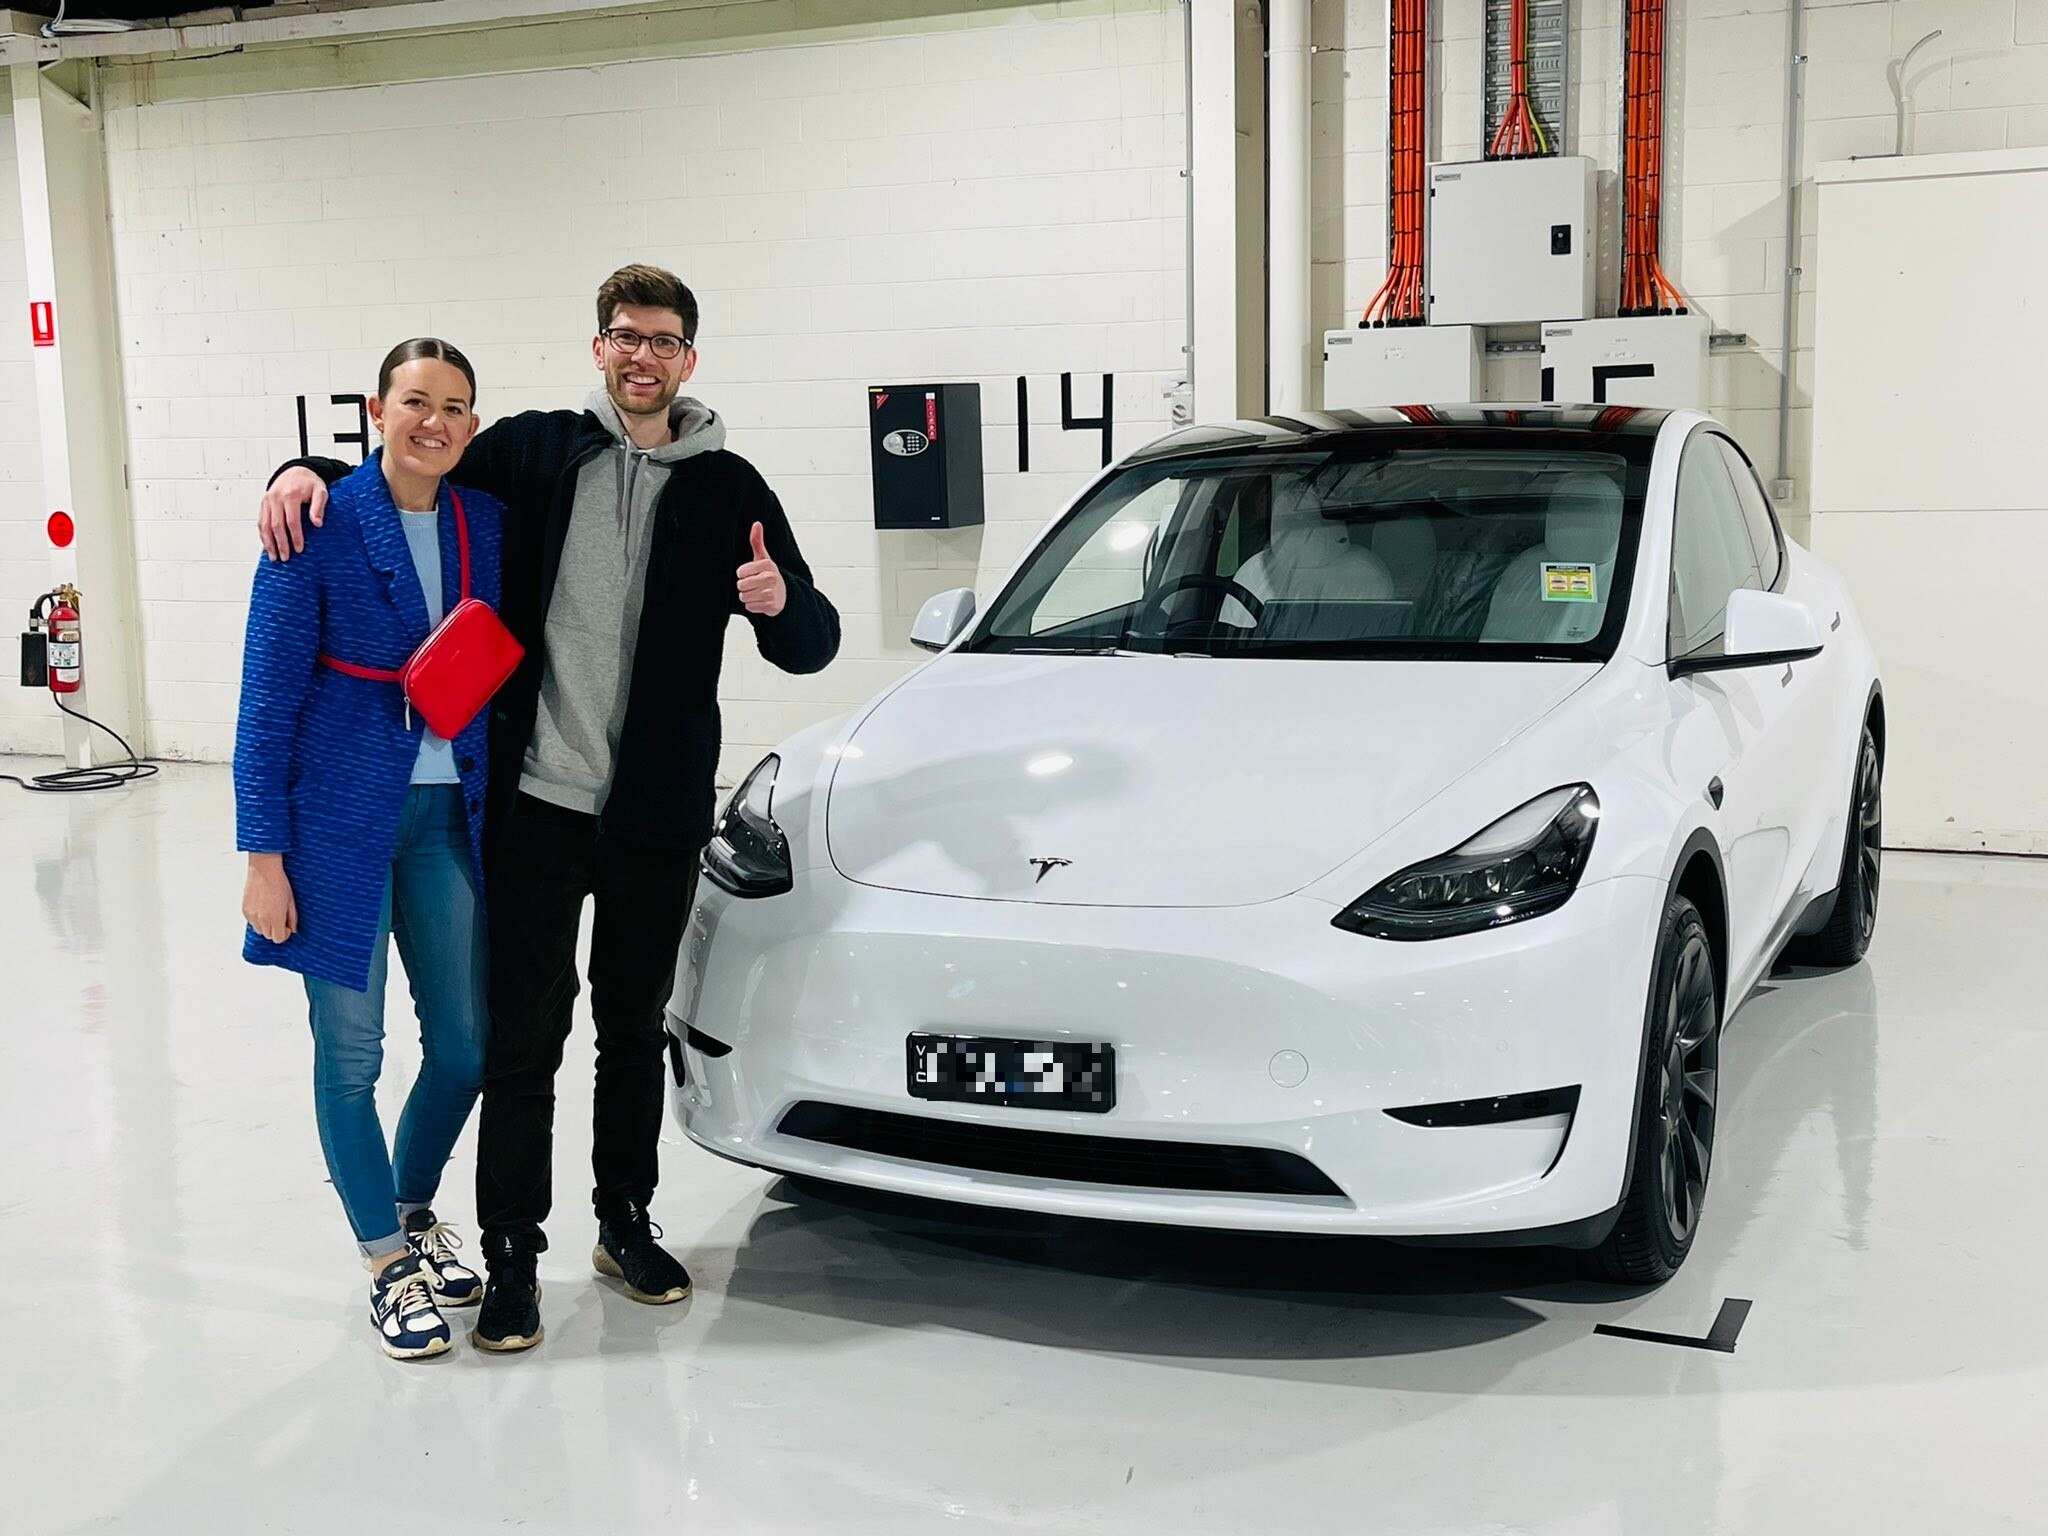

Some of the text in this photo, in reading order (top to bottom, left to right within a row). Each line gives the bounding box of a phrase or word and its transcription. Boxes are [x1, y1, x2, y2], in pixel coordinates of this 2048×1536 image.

[296, 394, 369, 463] 13
[1016, 371, 1114, 473] 14
[915, 1044, 926, 1083] VIC
